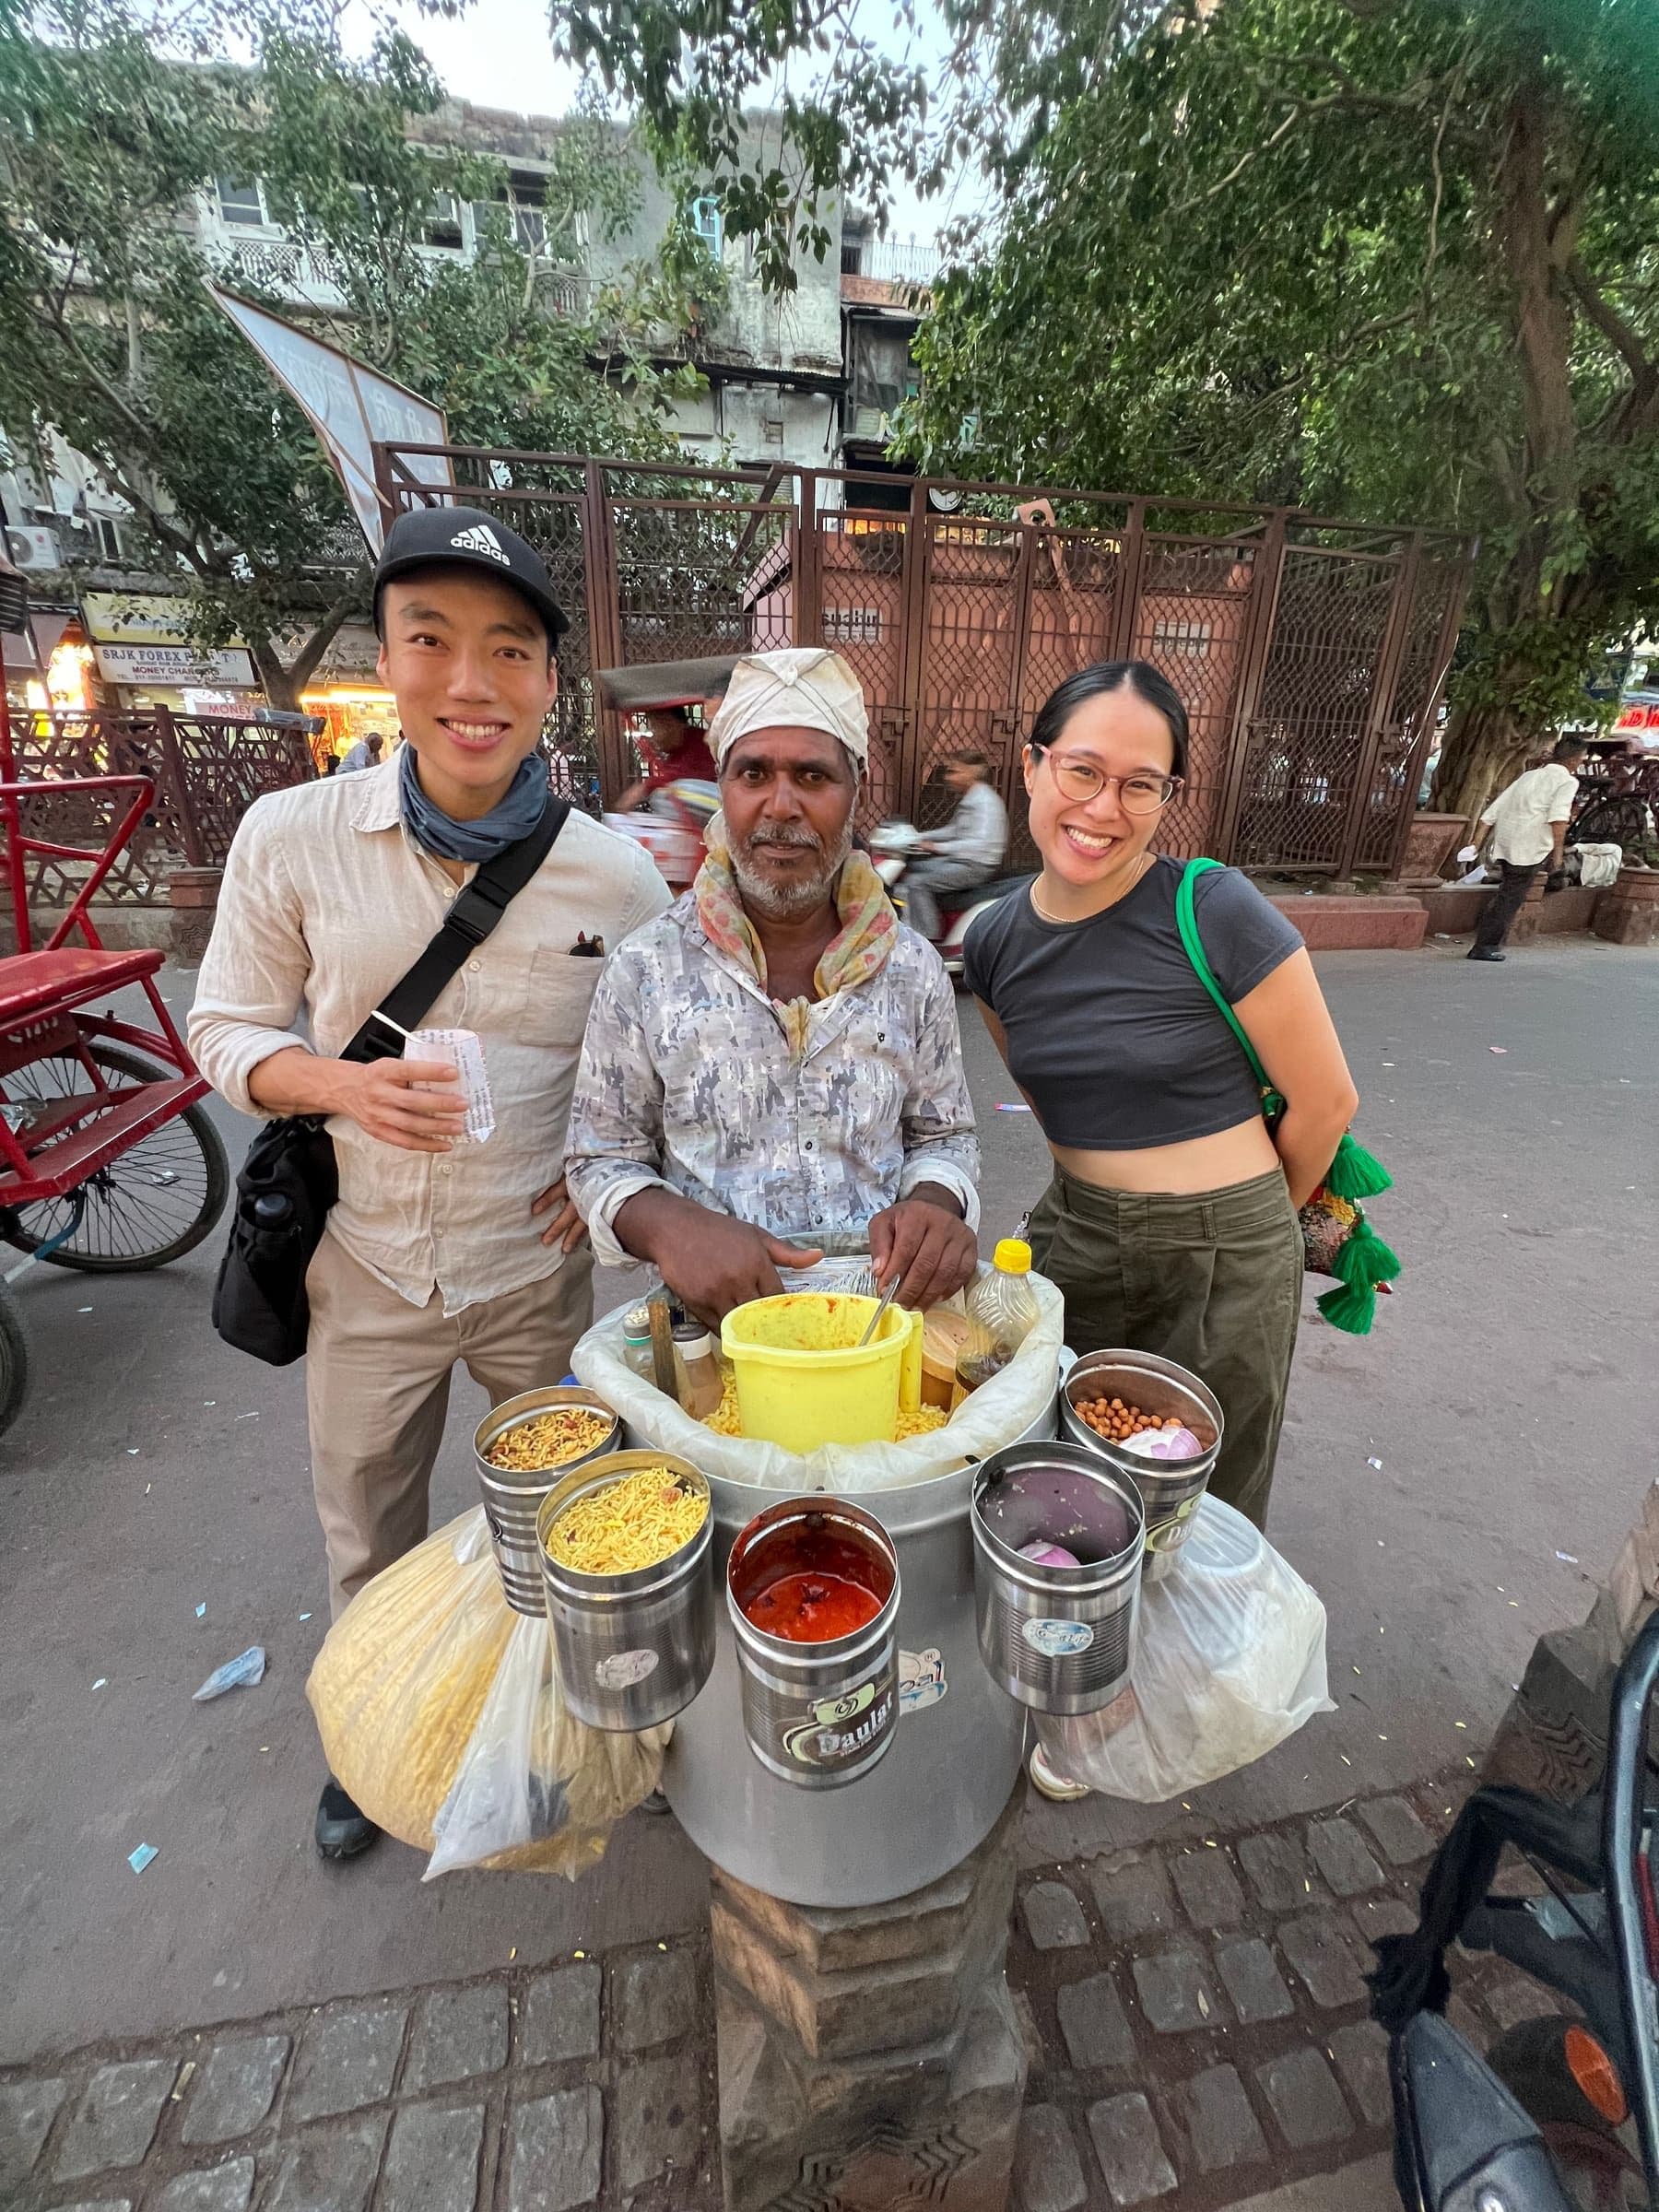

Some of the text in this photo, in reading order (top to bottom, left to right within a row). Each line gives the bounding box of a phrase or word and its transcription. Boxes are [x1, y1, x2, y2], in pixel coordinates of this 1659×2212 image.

[450, 536, 511, 566] adidas
[102, 649, 135, 660] SRJK
[137, 650, 182, 662] FOREX
[208, 704, 252, 714] MONEY
